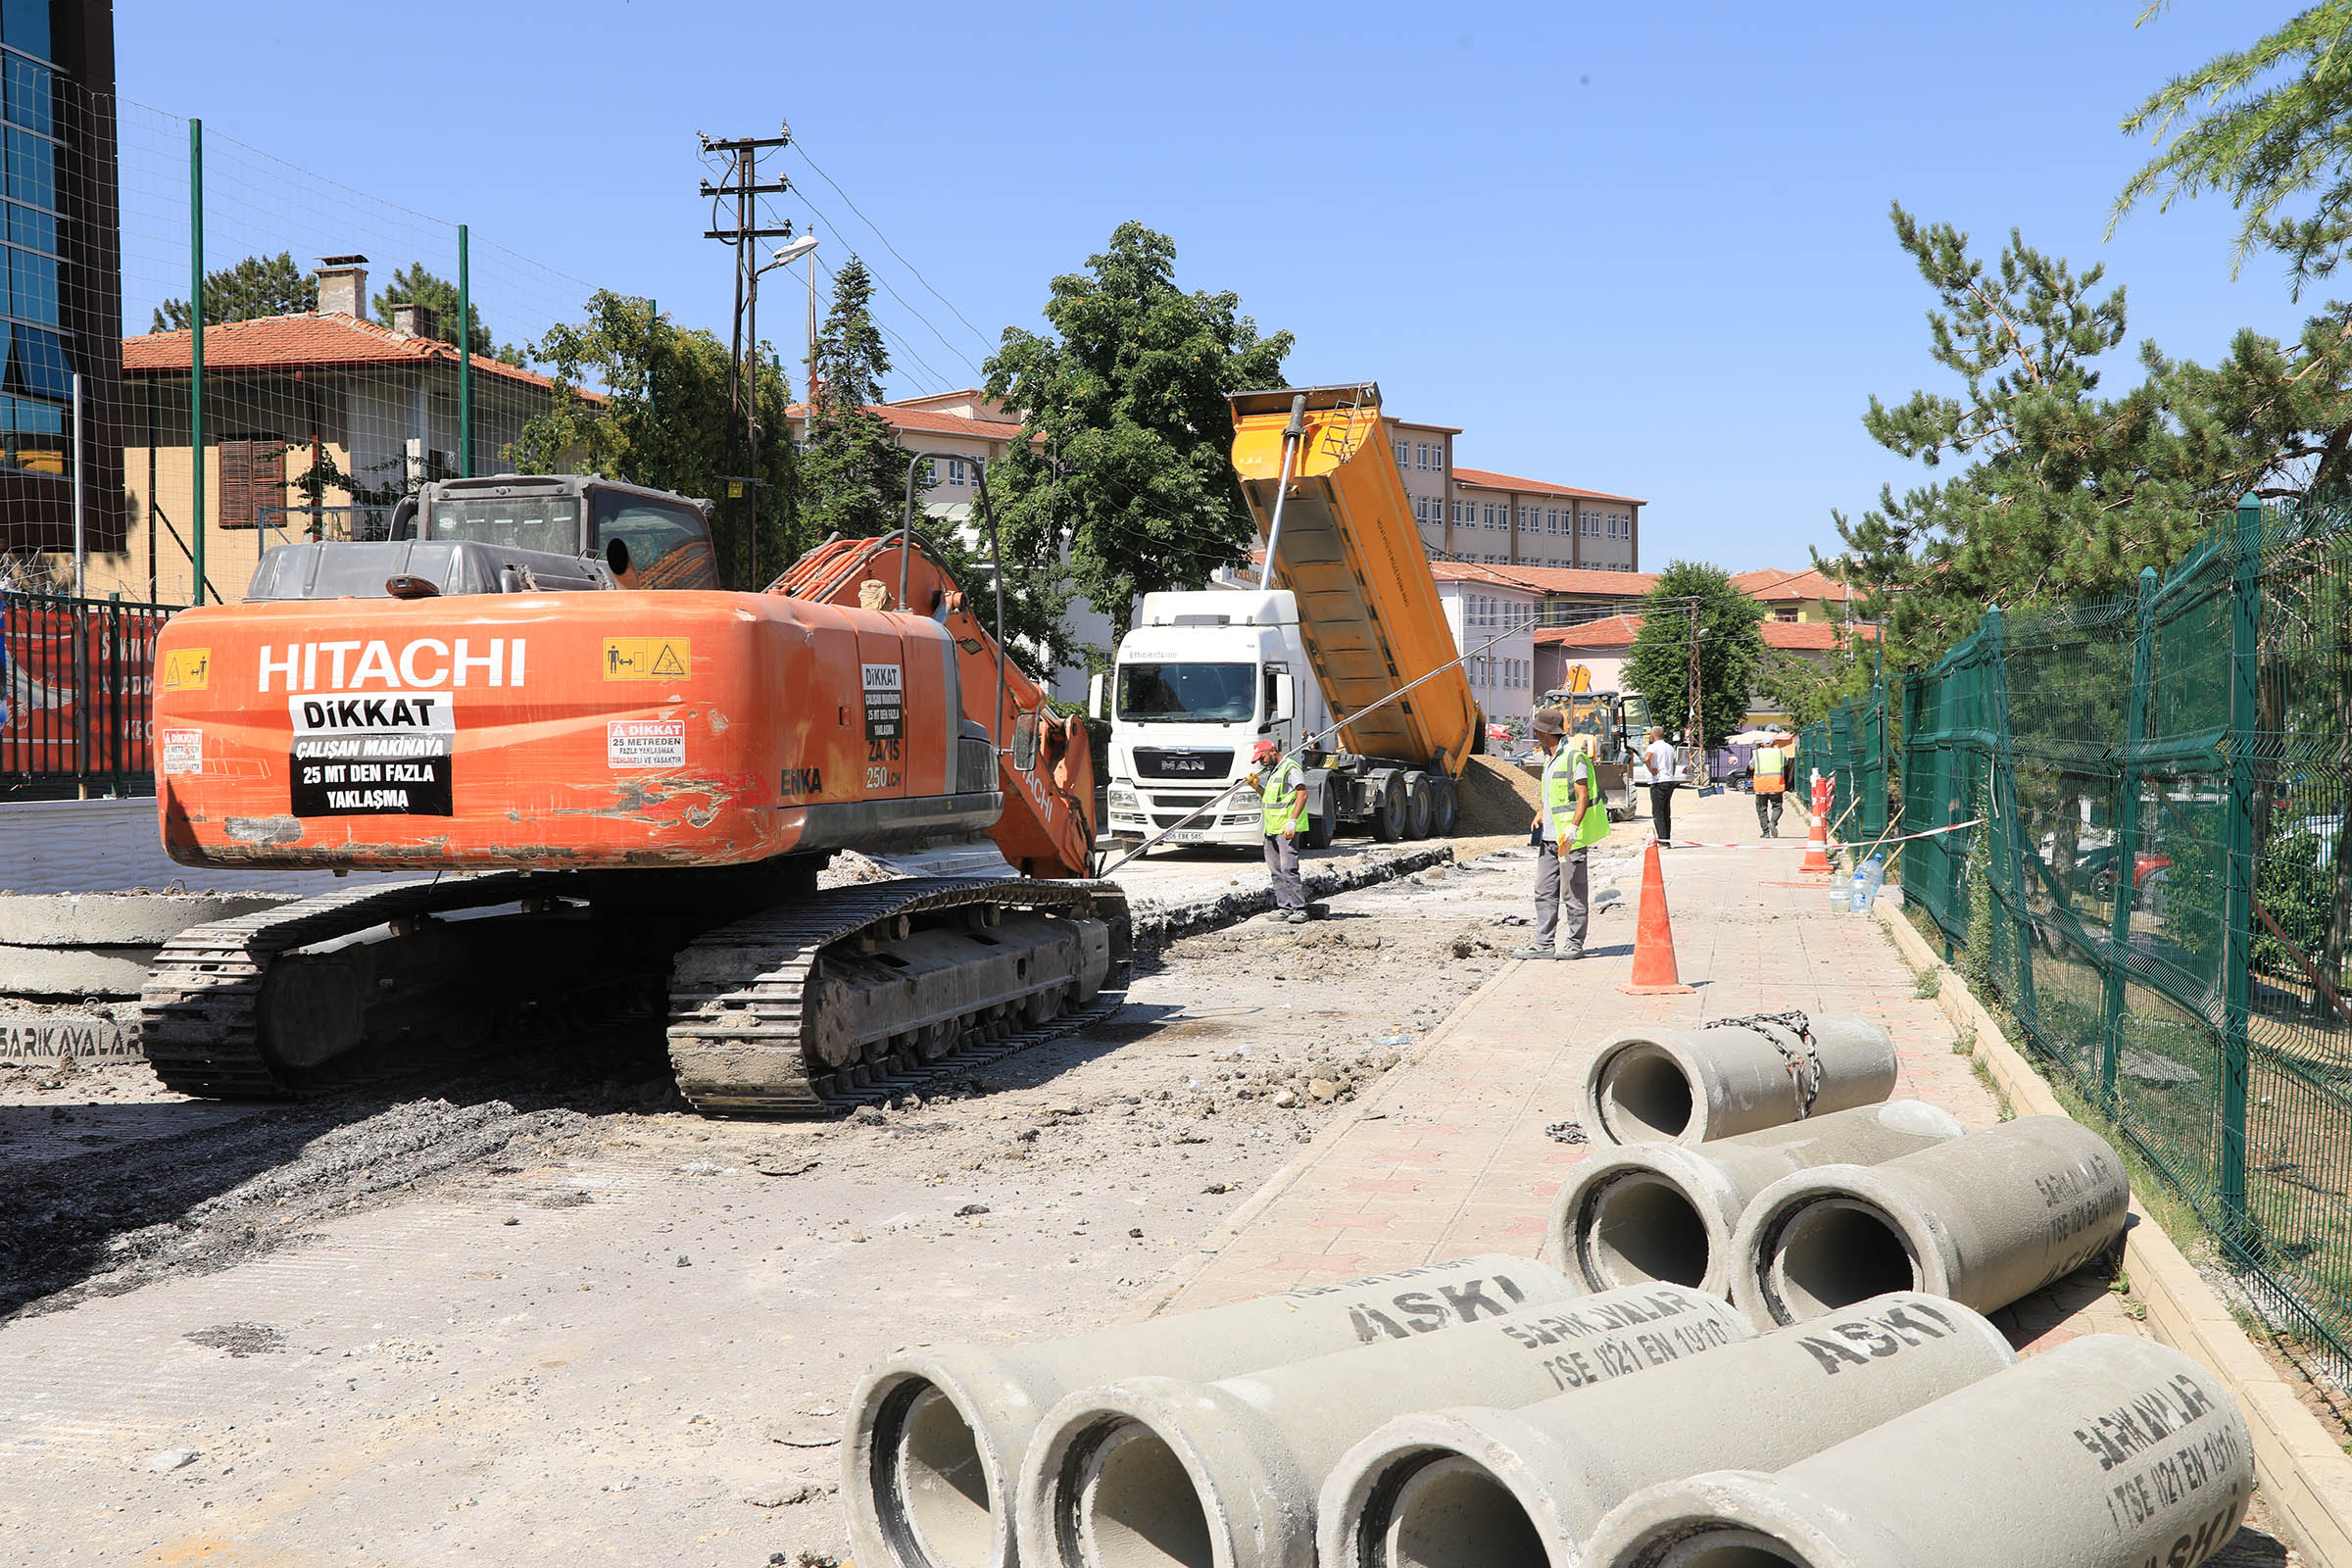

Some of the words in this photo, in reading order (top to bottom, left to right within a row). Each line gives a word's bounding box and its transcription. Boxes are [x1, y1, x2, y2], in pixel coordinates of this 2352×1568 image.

[259, 638, 526, 693] HITACHI
[295, 739, 360, 760] ÇALIŞAN
[612, 738, 625, 747] 25
[303, 765, 321, 785] 25
[324, 764, 347, 783] MT
[350, 764, 381, 782] DEN
[385, 764, 435, 782] FAZLA
[1161, 760, 1205, 770] MAN
[781, 767, 823, 796] ENKA
[866, 766, 887, 789] 250
[326, 789, 410, 809] YAKLAŞMA
[1544, 1351, 1599, 1392] TSE
[1636, 1332, 1679, 1366] EN
[2113, 1474, 2155, 1530] TSE
[2177, 1444, 2208, 1491] EN
